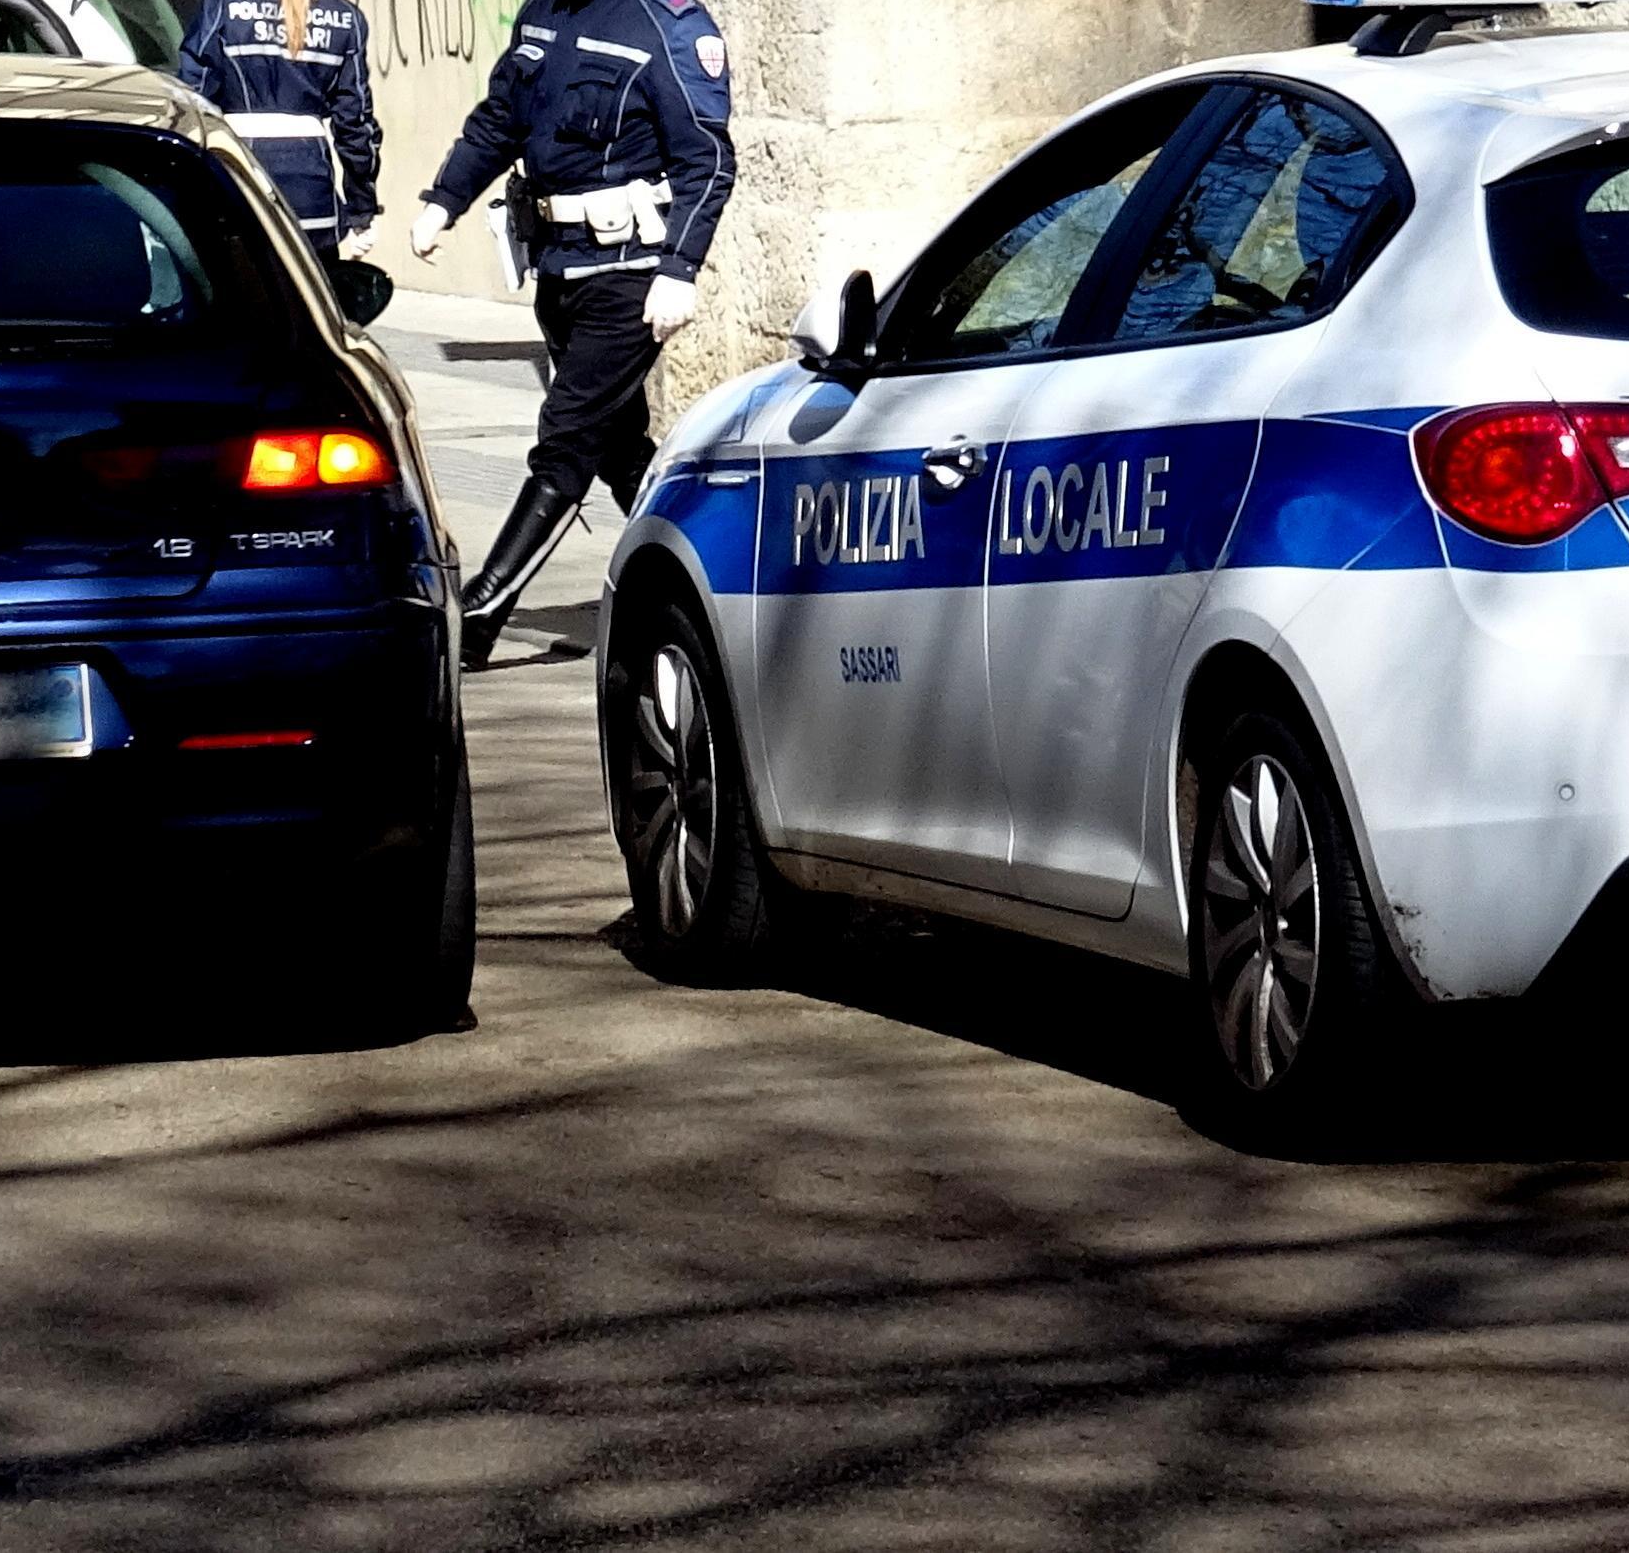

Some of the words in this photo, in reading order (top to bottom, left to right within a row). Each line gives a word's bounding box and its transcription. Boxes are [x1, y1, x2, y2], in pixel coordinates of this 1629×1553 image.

[792, 474, 926, 567] POLIZIA
[998, 455, 1170, 556] LOCALE
[839, 646, 902, 684] SASSARI
